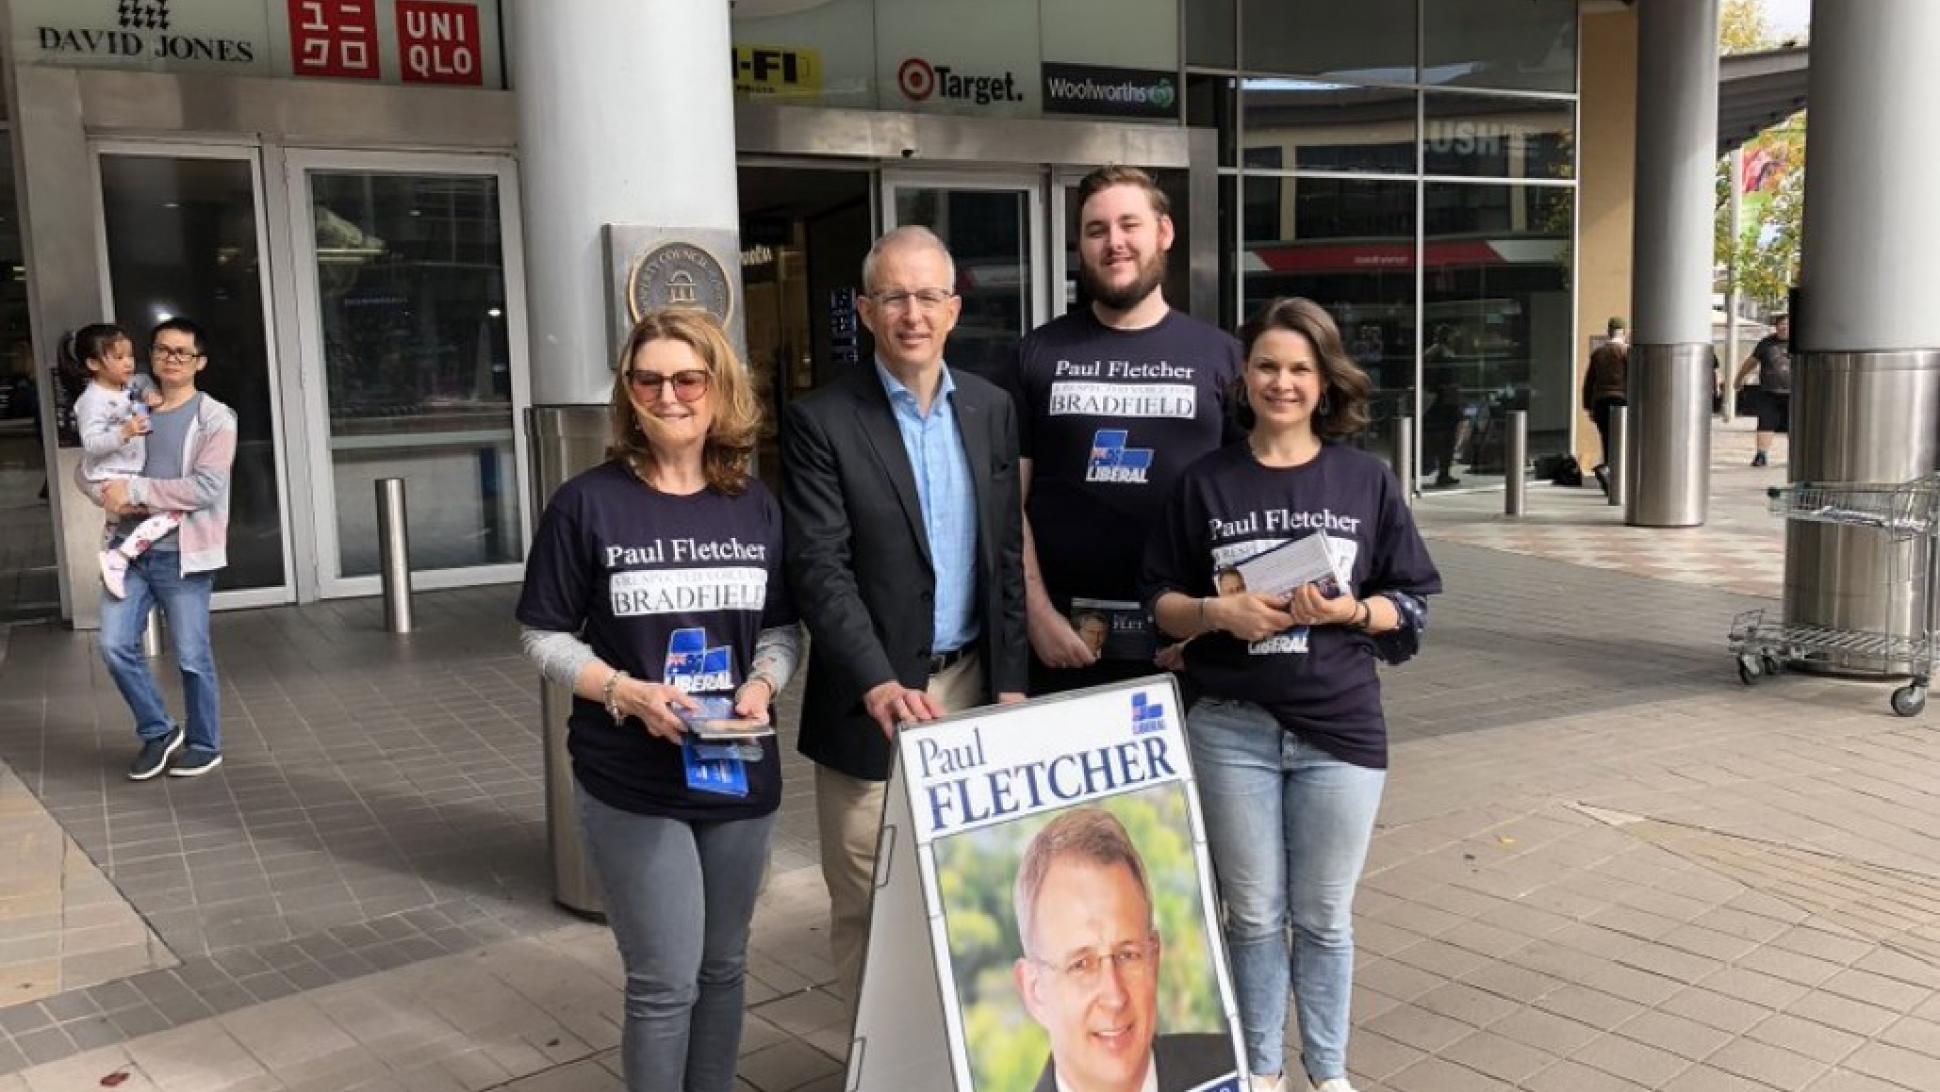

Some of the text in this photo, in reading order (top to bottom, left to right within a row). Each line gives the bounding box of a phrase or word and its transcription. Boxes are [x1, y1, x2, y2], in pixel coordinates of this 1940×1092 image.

[406, 10, 465, 41] UNI
[37, 26, 254, 62] DAVID JONES
[409, 44, 472, 77] QLO
[934, 65, 1024, 105] Target.
[1049, 77, 1147, 103] Woolworths
[1423, 120, 1501, 154] USH
[1055, 360, 1196, 380] Paul Fletcher
[1051, 394, 1193, 416] BRADFIELD
[1086, 466, 1149, 483] LIBERAL
[1208, 509, 1361, 540] Paul Fletcher
[606, 537, 767, 568] Paul Fletcher
[613, 584, 766, 614] BRADFIELD
[1248, 635, 1308, 655] LIBERAL
[665, 673, 734, 690] LIBERAL
[917, 726, 988, 778] Paul
[925, 736, 1177, 831] FLETCHER
